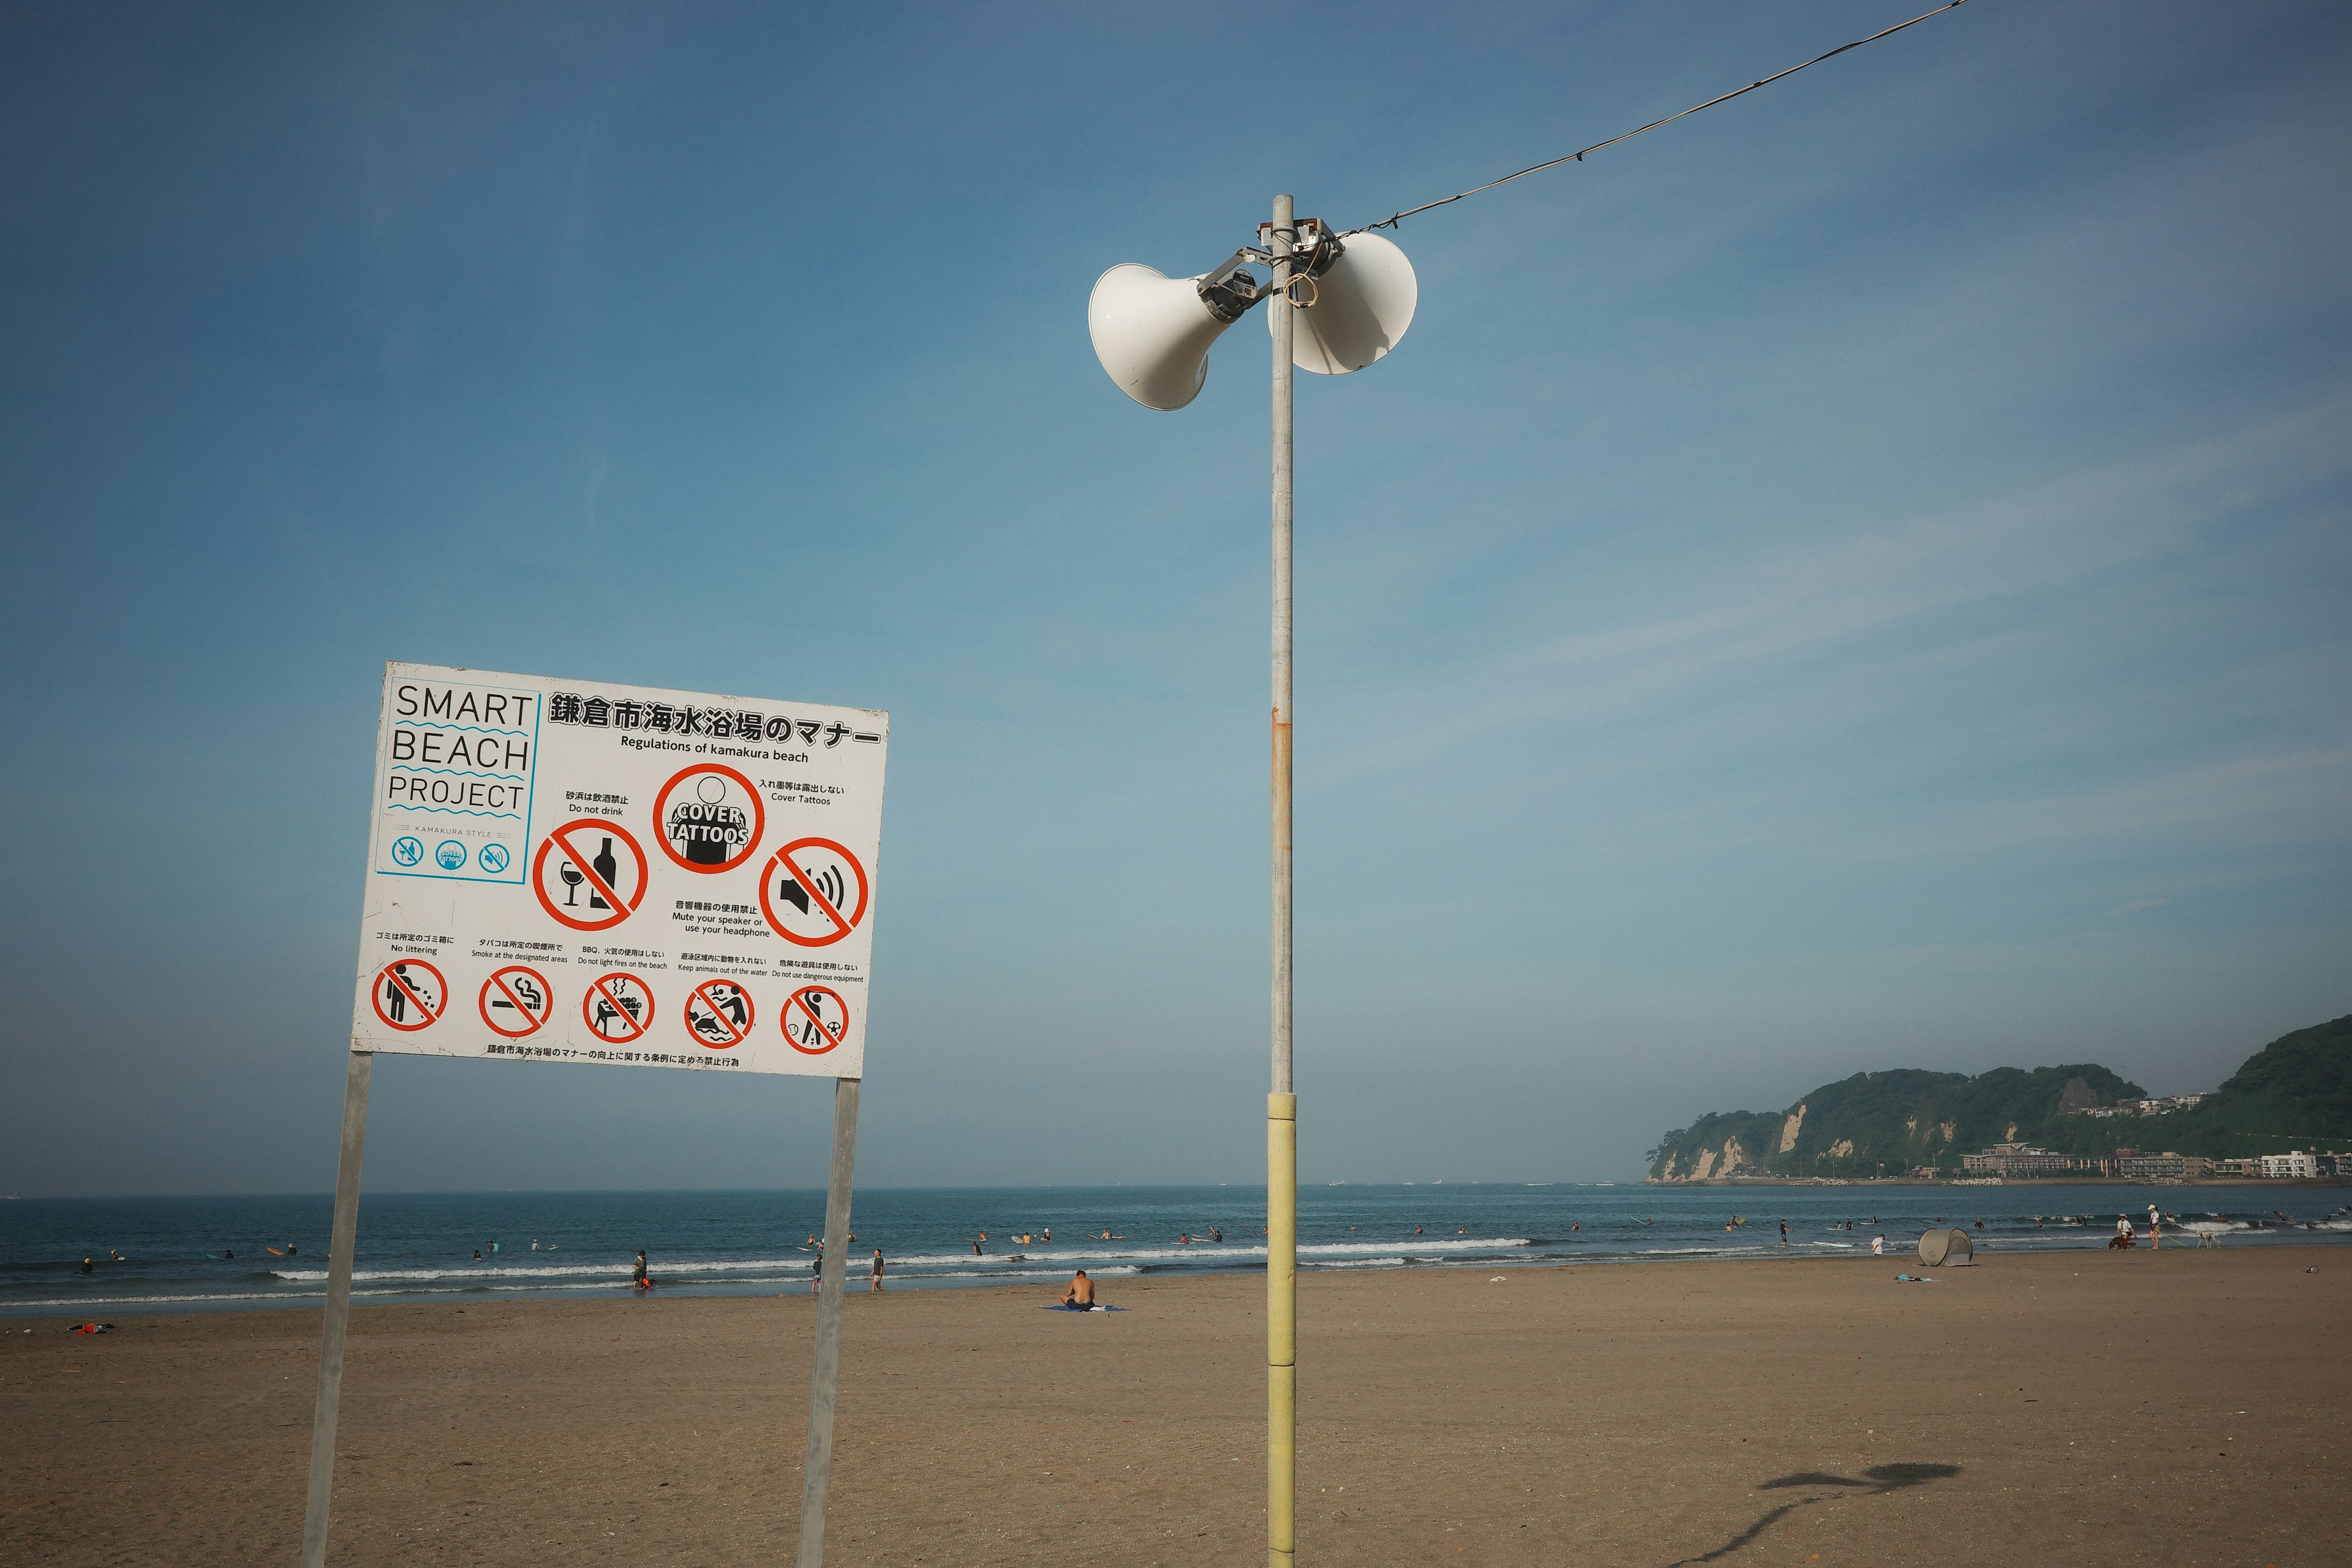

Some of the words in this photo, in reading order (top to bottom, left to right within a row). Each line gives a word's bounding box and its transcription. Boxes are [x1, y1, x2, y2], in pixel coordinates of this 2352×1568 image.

[396, 685, 532, 726] SMART
[549, 693, 881, 748] 鎌倉市海水浴場のマナー
[393, 729, 528, 771] BEACH
[621, 736, 691, 752] Regulations
[695, 743, 707, 753] of
[711, 744, 769, 759] kamakura
[773, 750, 808, 763] beach
[389, 776, 524, 809] PROJECT
[759, 779, 844, 794] 入れ墨等は露出しない
[565, 791, 629, 804] 砂浜は飲酒禁止
[771, 793, 796, 802] Cover
[798, 795, 831, 805] Tattoos
[569, 804, 582, 812] Do
[601, 807, 624, 816] drink
[676, 802, 741, 824] COVER
[415, 826, 463, 835] KAMAKURA
[666, 821, 748, 845] TATTOOS
[675, 900, 758, 914] 音響機器の使用禁止
[672, 912, 695, 921] Mute
[718, 917, 752, 925] speaker
[702, 926, 721, 935] your
[723, 927, 770, 937] headphone
[376, 932, 454, 944] ゴミは所定のゴミ箱に
[405, 945, 437, 956] littering
[479, 939, 563, 951] タバコは所定の喫煙所で
[514, 953, 549, 962] designated
[582, 946, 665, 958] BBQ、火気の使用はしない
[600, 959, 613, 967] light
[680, 952, 766, 965] 遊泳区域内に動物を入れない
[678, 964, 693, 973] Keep
[779, 959, 858, 971] 危険な遊具は使用しない
[803, 973, 832, 981] dangerous
[834, 974, 864, 983] equipment
